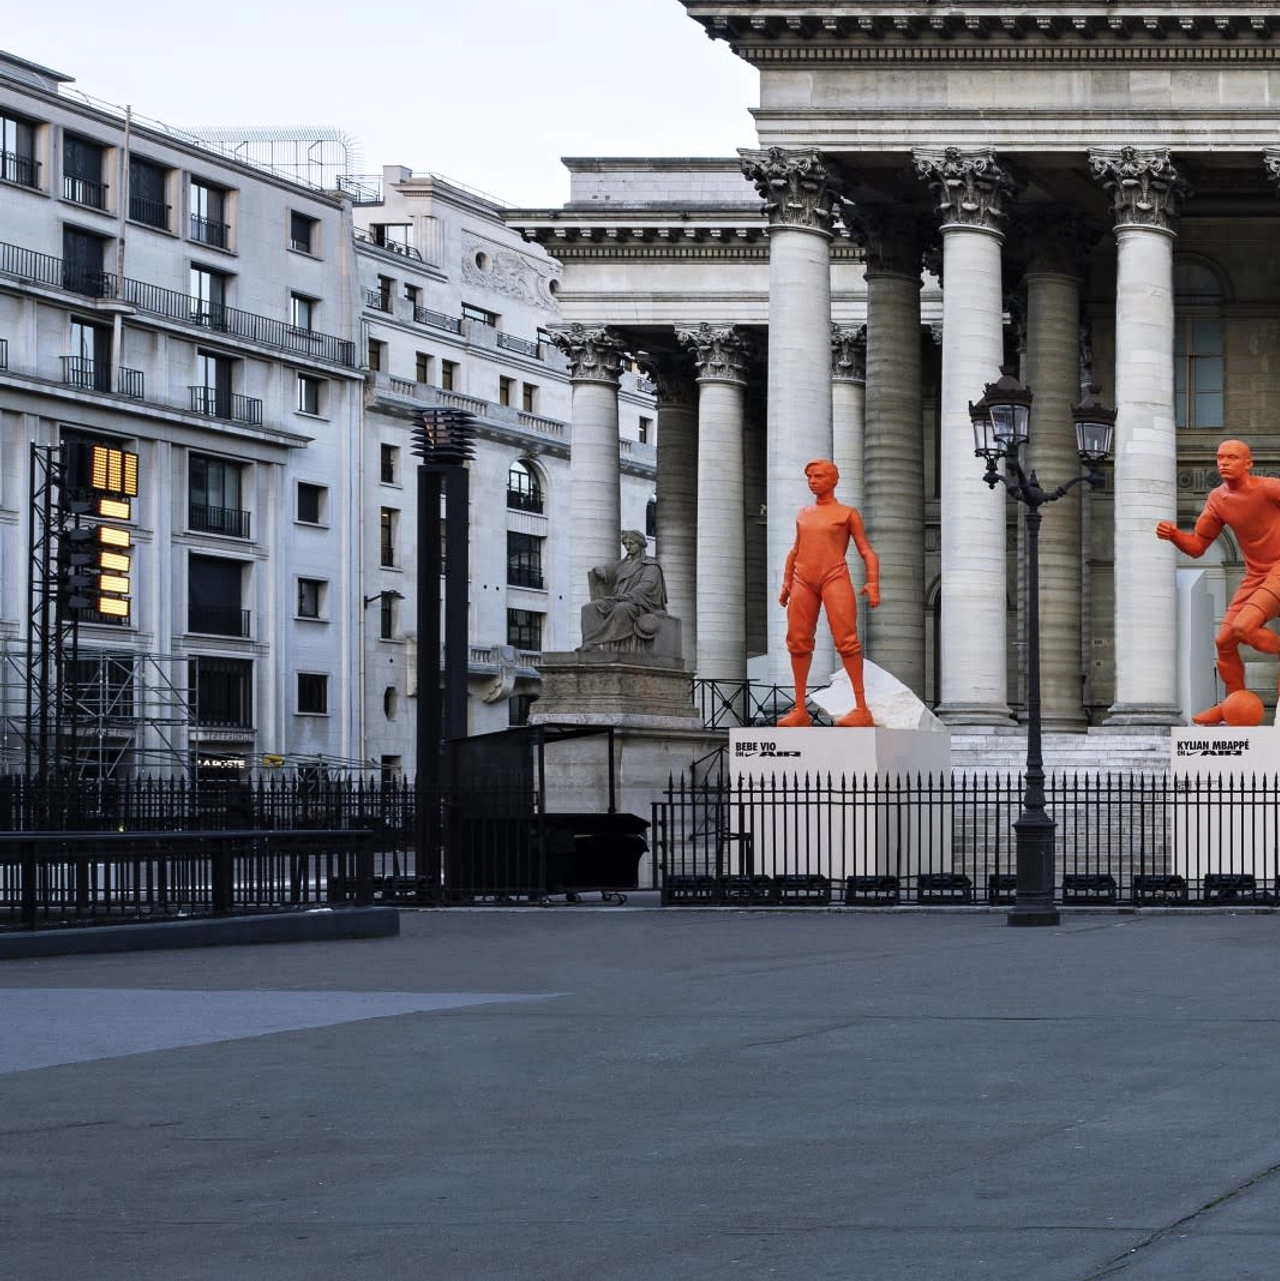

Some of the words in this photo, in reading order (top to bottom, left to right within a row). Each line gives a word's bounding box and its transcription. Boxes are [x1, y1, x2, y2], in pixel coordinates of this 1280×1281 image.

[736, 742, 758, 751] BEBE
[760, 742, 776, 751] VIO
[1177, 741, 1209, 750] KYLIAN
[1212, 739, 1249, 750] MBAPPÉ
